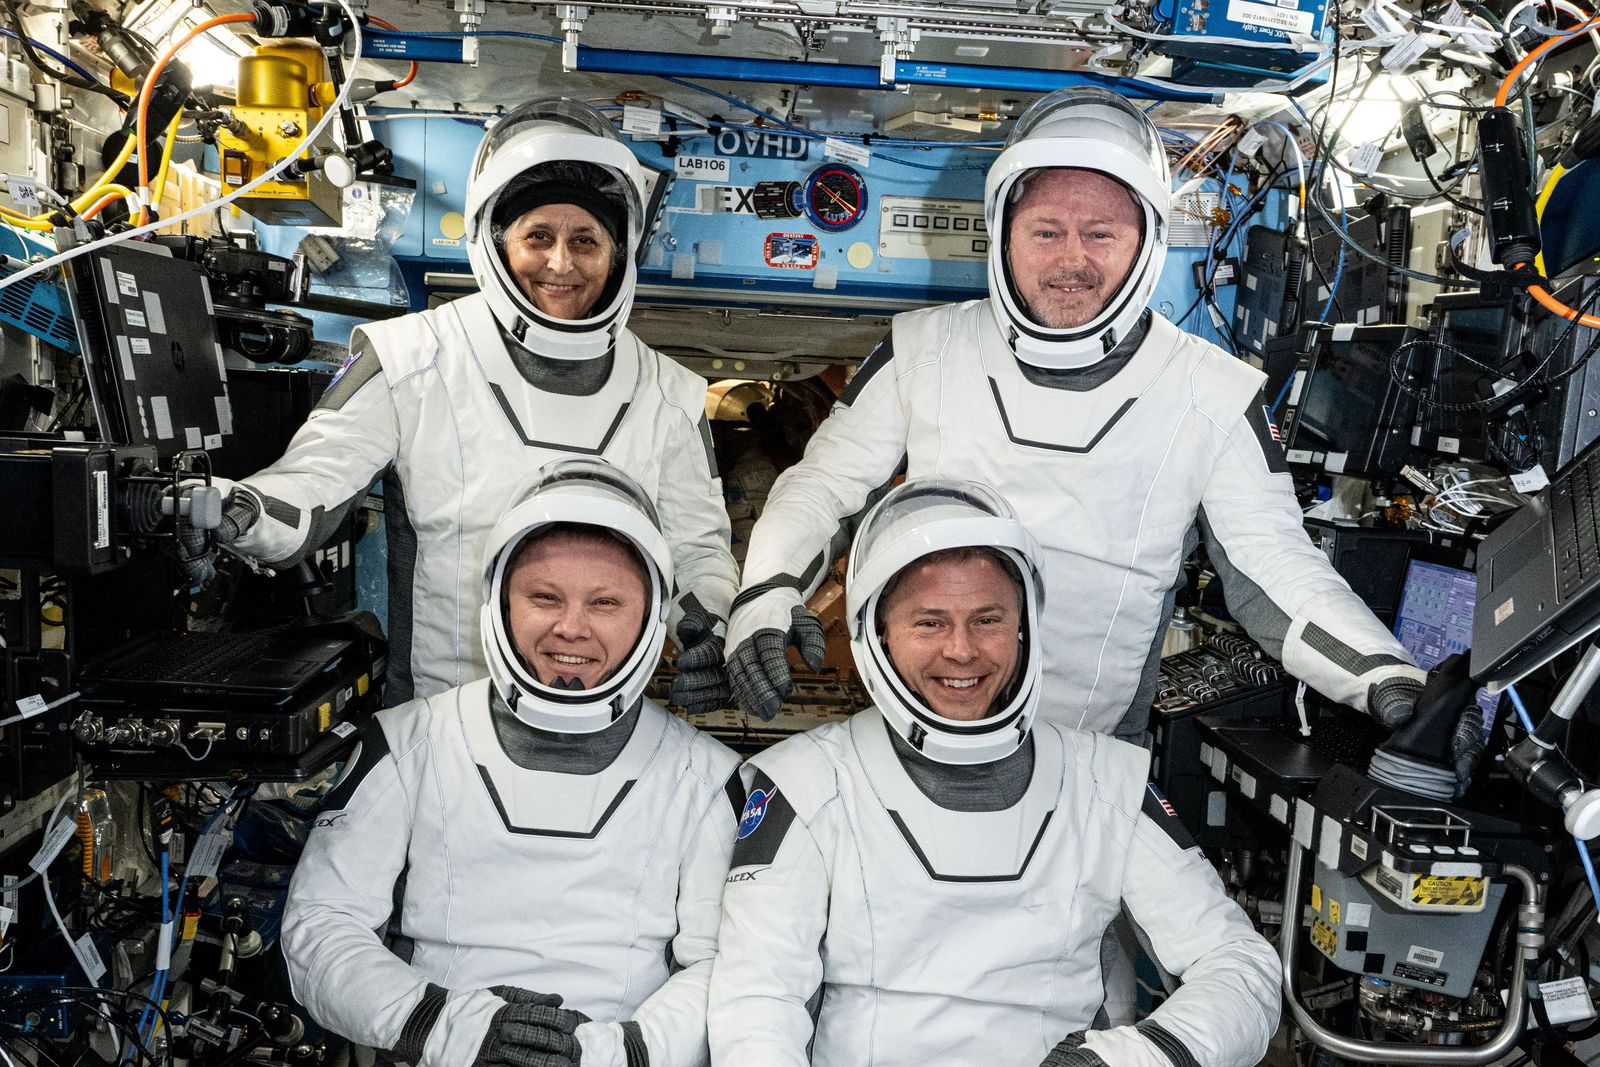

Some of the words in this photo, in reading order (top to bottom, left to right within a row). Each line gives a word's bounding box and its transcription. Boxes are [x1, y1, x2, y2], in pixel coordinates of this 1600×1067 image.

[1242, 23, 1258, 33] Supply
[1259, 28, 1273, 36] Power
[717, 130, 806, 159] OVHD
